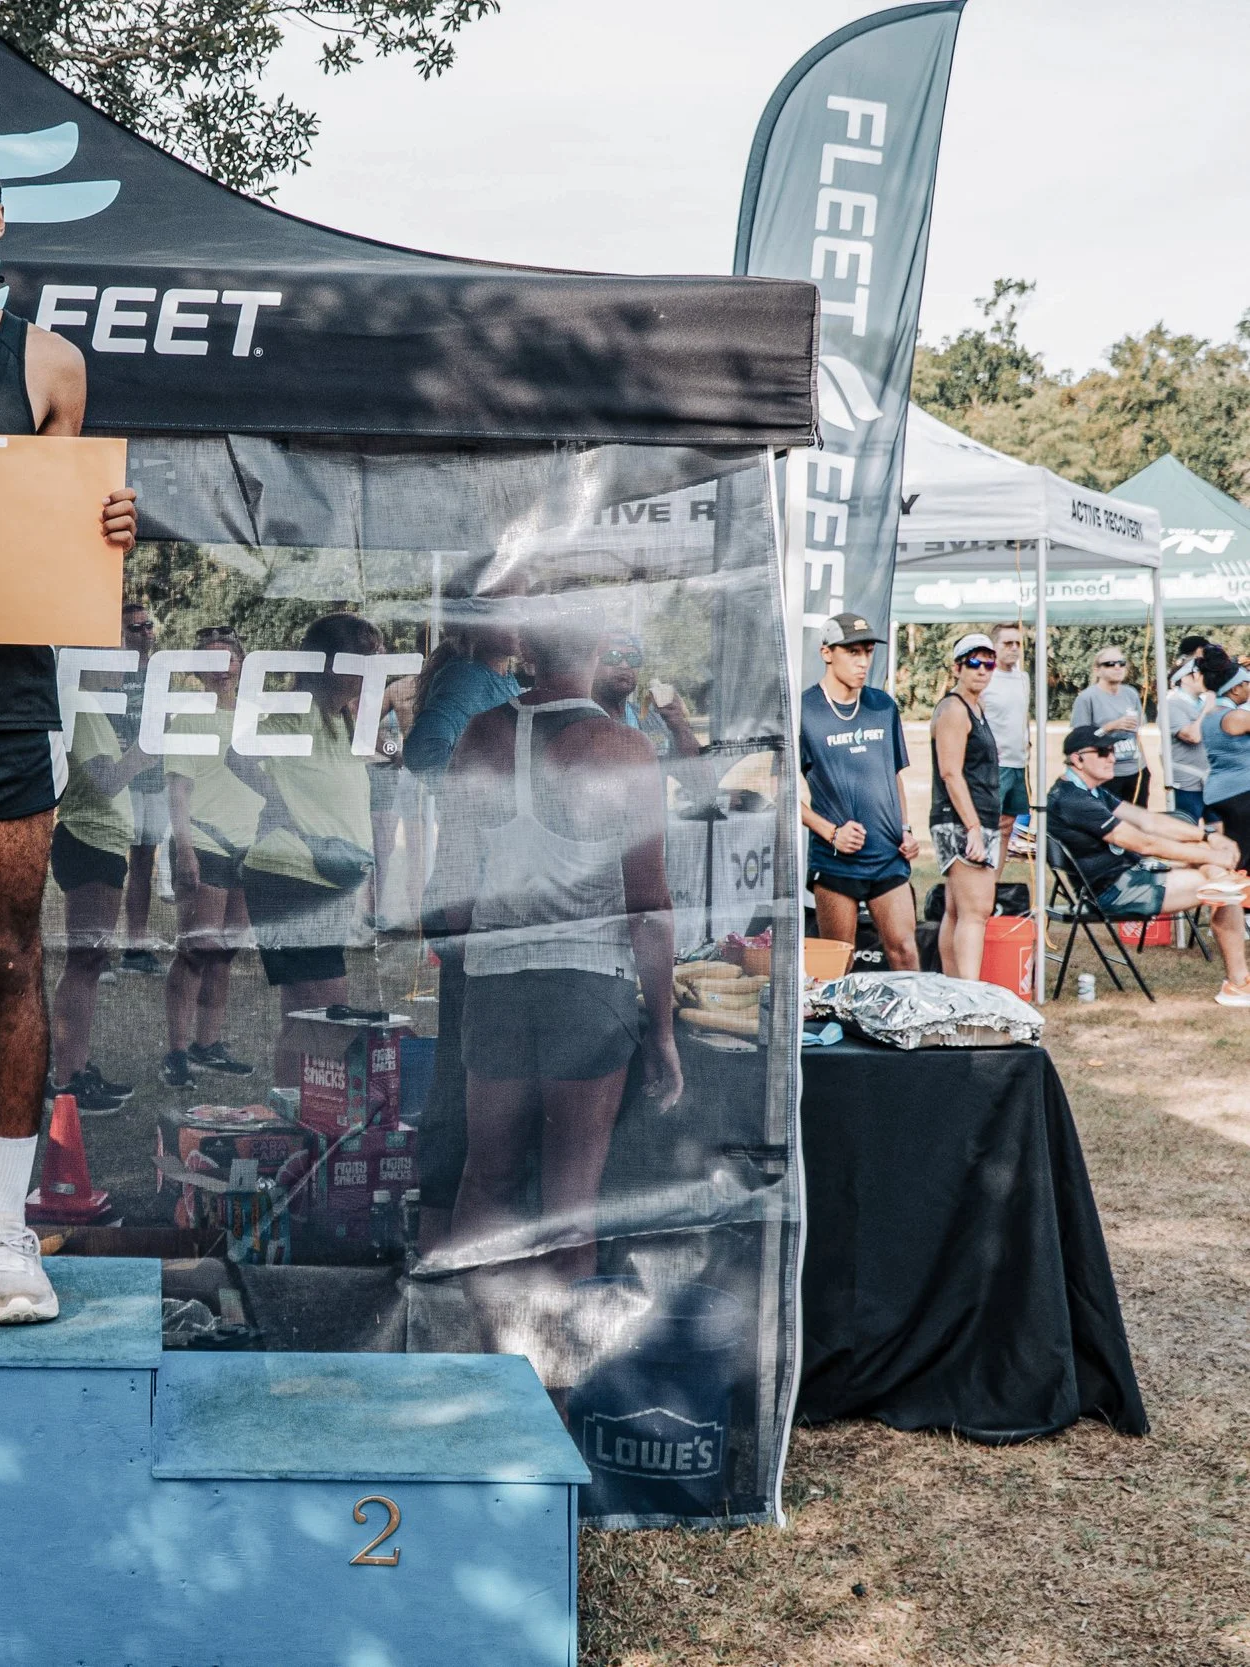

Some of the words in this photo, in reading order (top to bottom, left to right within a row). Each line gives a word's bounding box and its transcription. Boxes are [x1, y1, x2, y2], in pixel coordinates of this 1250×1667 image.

[810, 94, 887, 337] FLEET
[40, 284, 282, 357] FEET
[1071, 499, 1102, 529] ACTIVE
[1103, 509, 1144, 542] RECOVERY
[1061, 580, 1111, 596] need
[56, 647, 423, 758] FEET
[826, 732, 854, 746] FLEET
[863, 729, 885, 741] FEET
[303, 1068, 346, 1090] SNACKS
[596, 1425, 713, 1471] LOWE'S
[350, 1494, 402, 1567] 2
